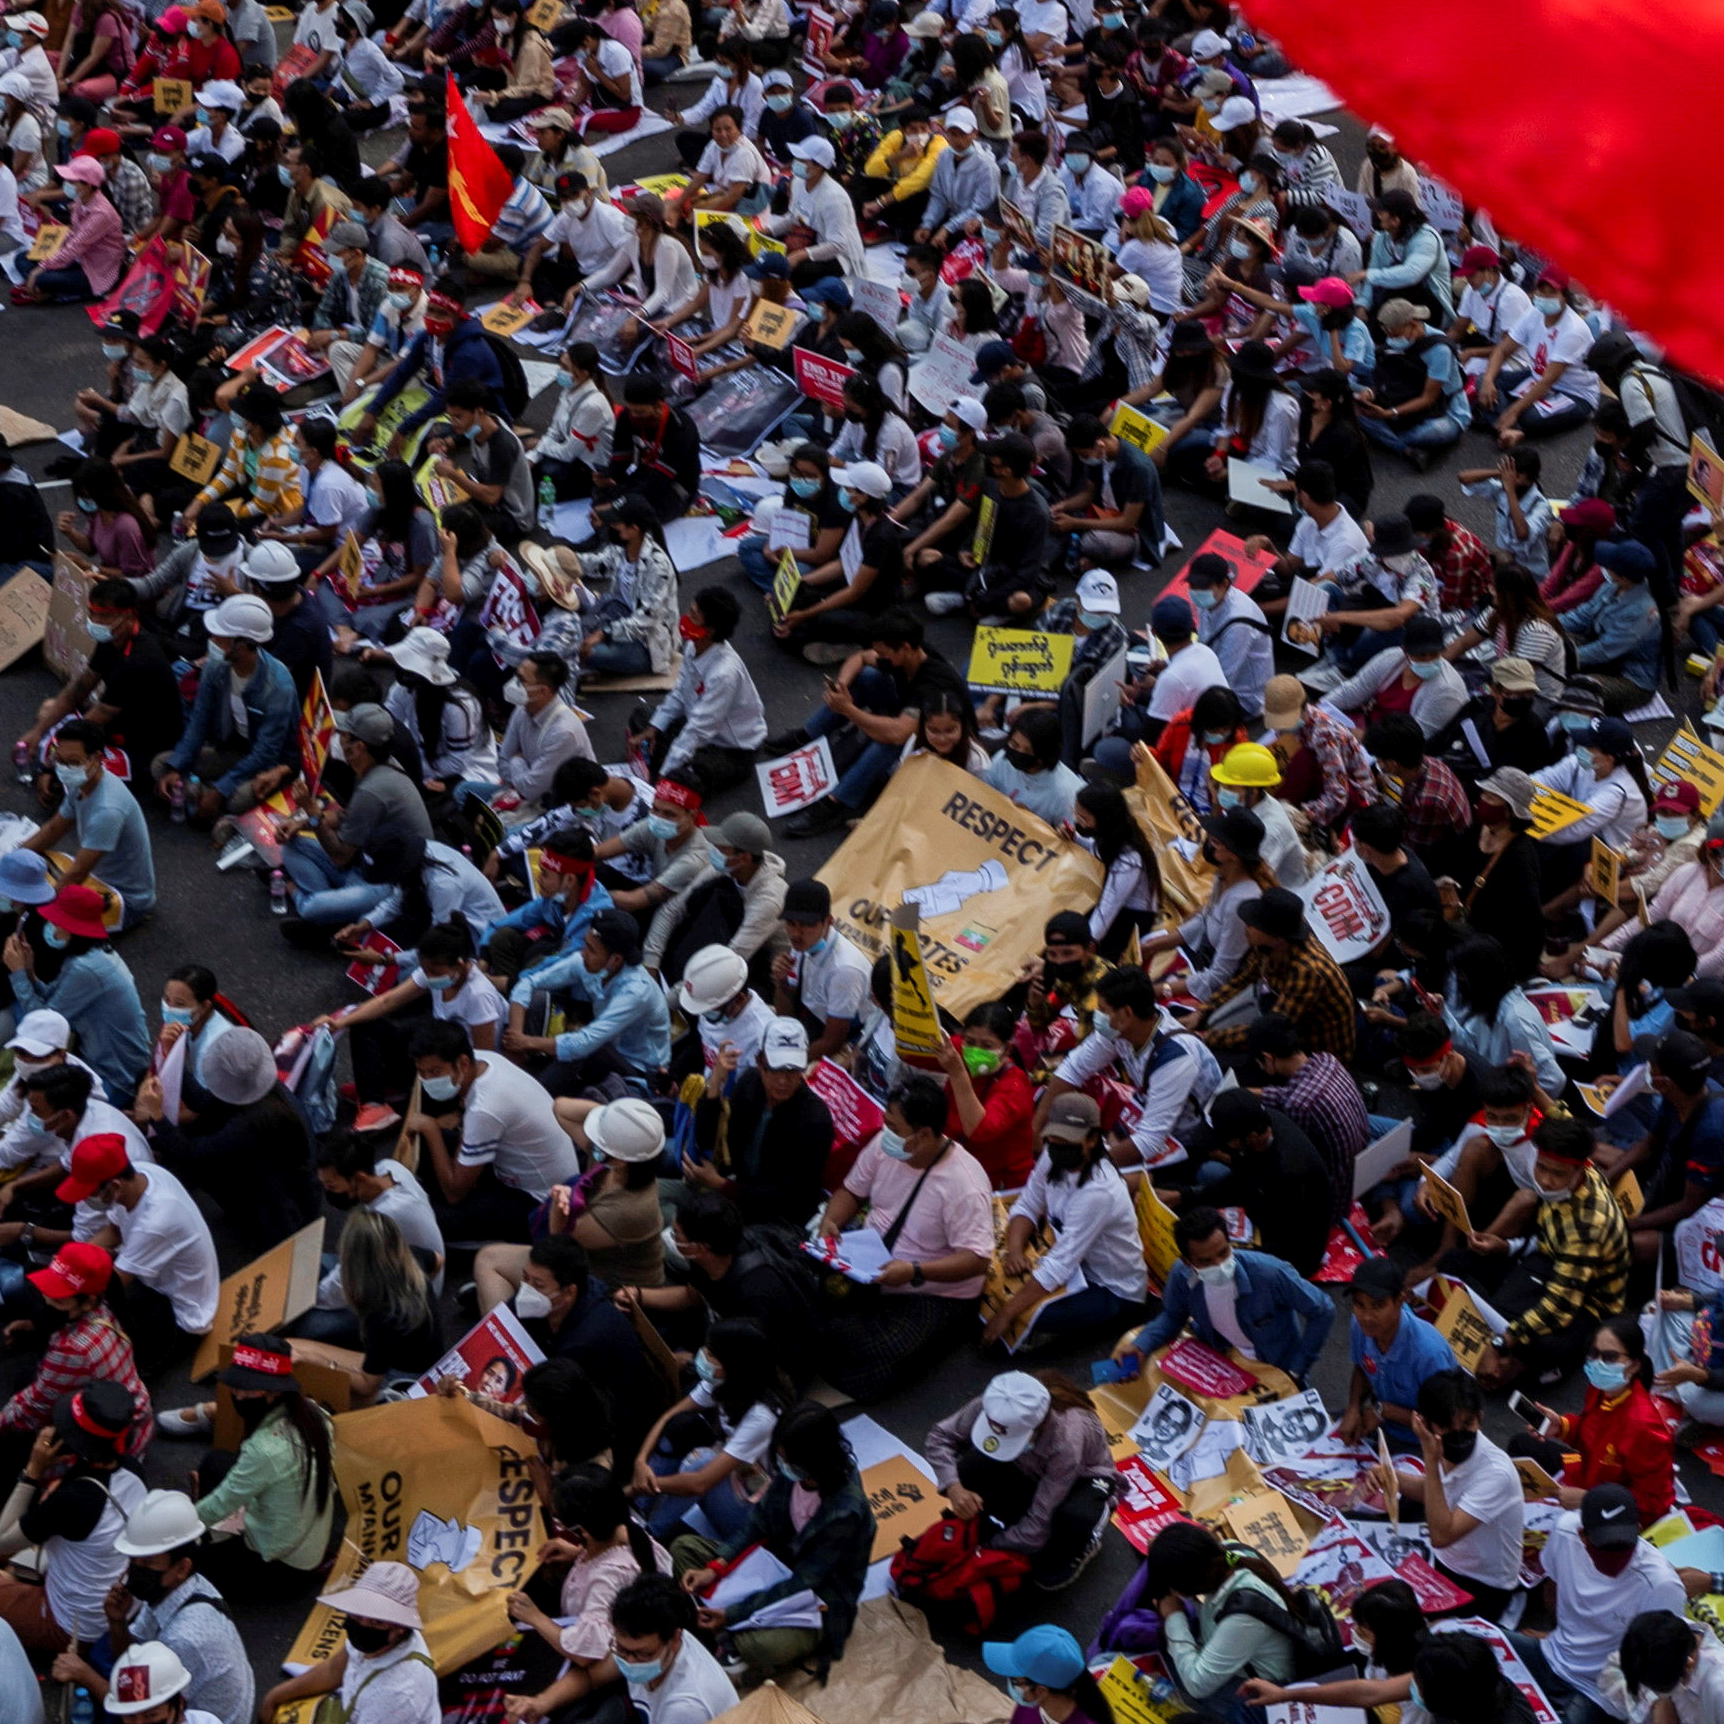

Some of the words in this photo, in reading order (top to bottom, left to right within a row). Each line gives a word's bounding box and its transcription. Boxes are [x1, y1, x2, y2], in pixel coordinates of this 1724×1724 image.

[942, 790, 1060, 875] RESPECT
[379, 1470, 403, 1557] OUR
[459, 1672, 477, 1684] DO
